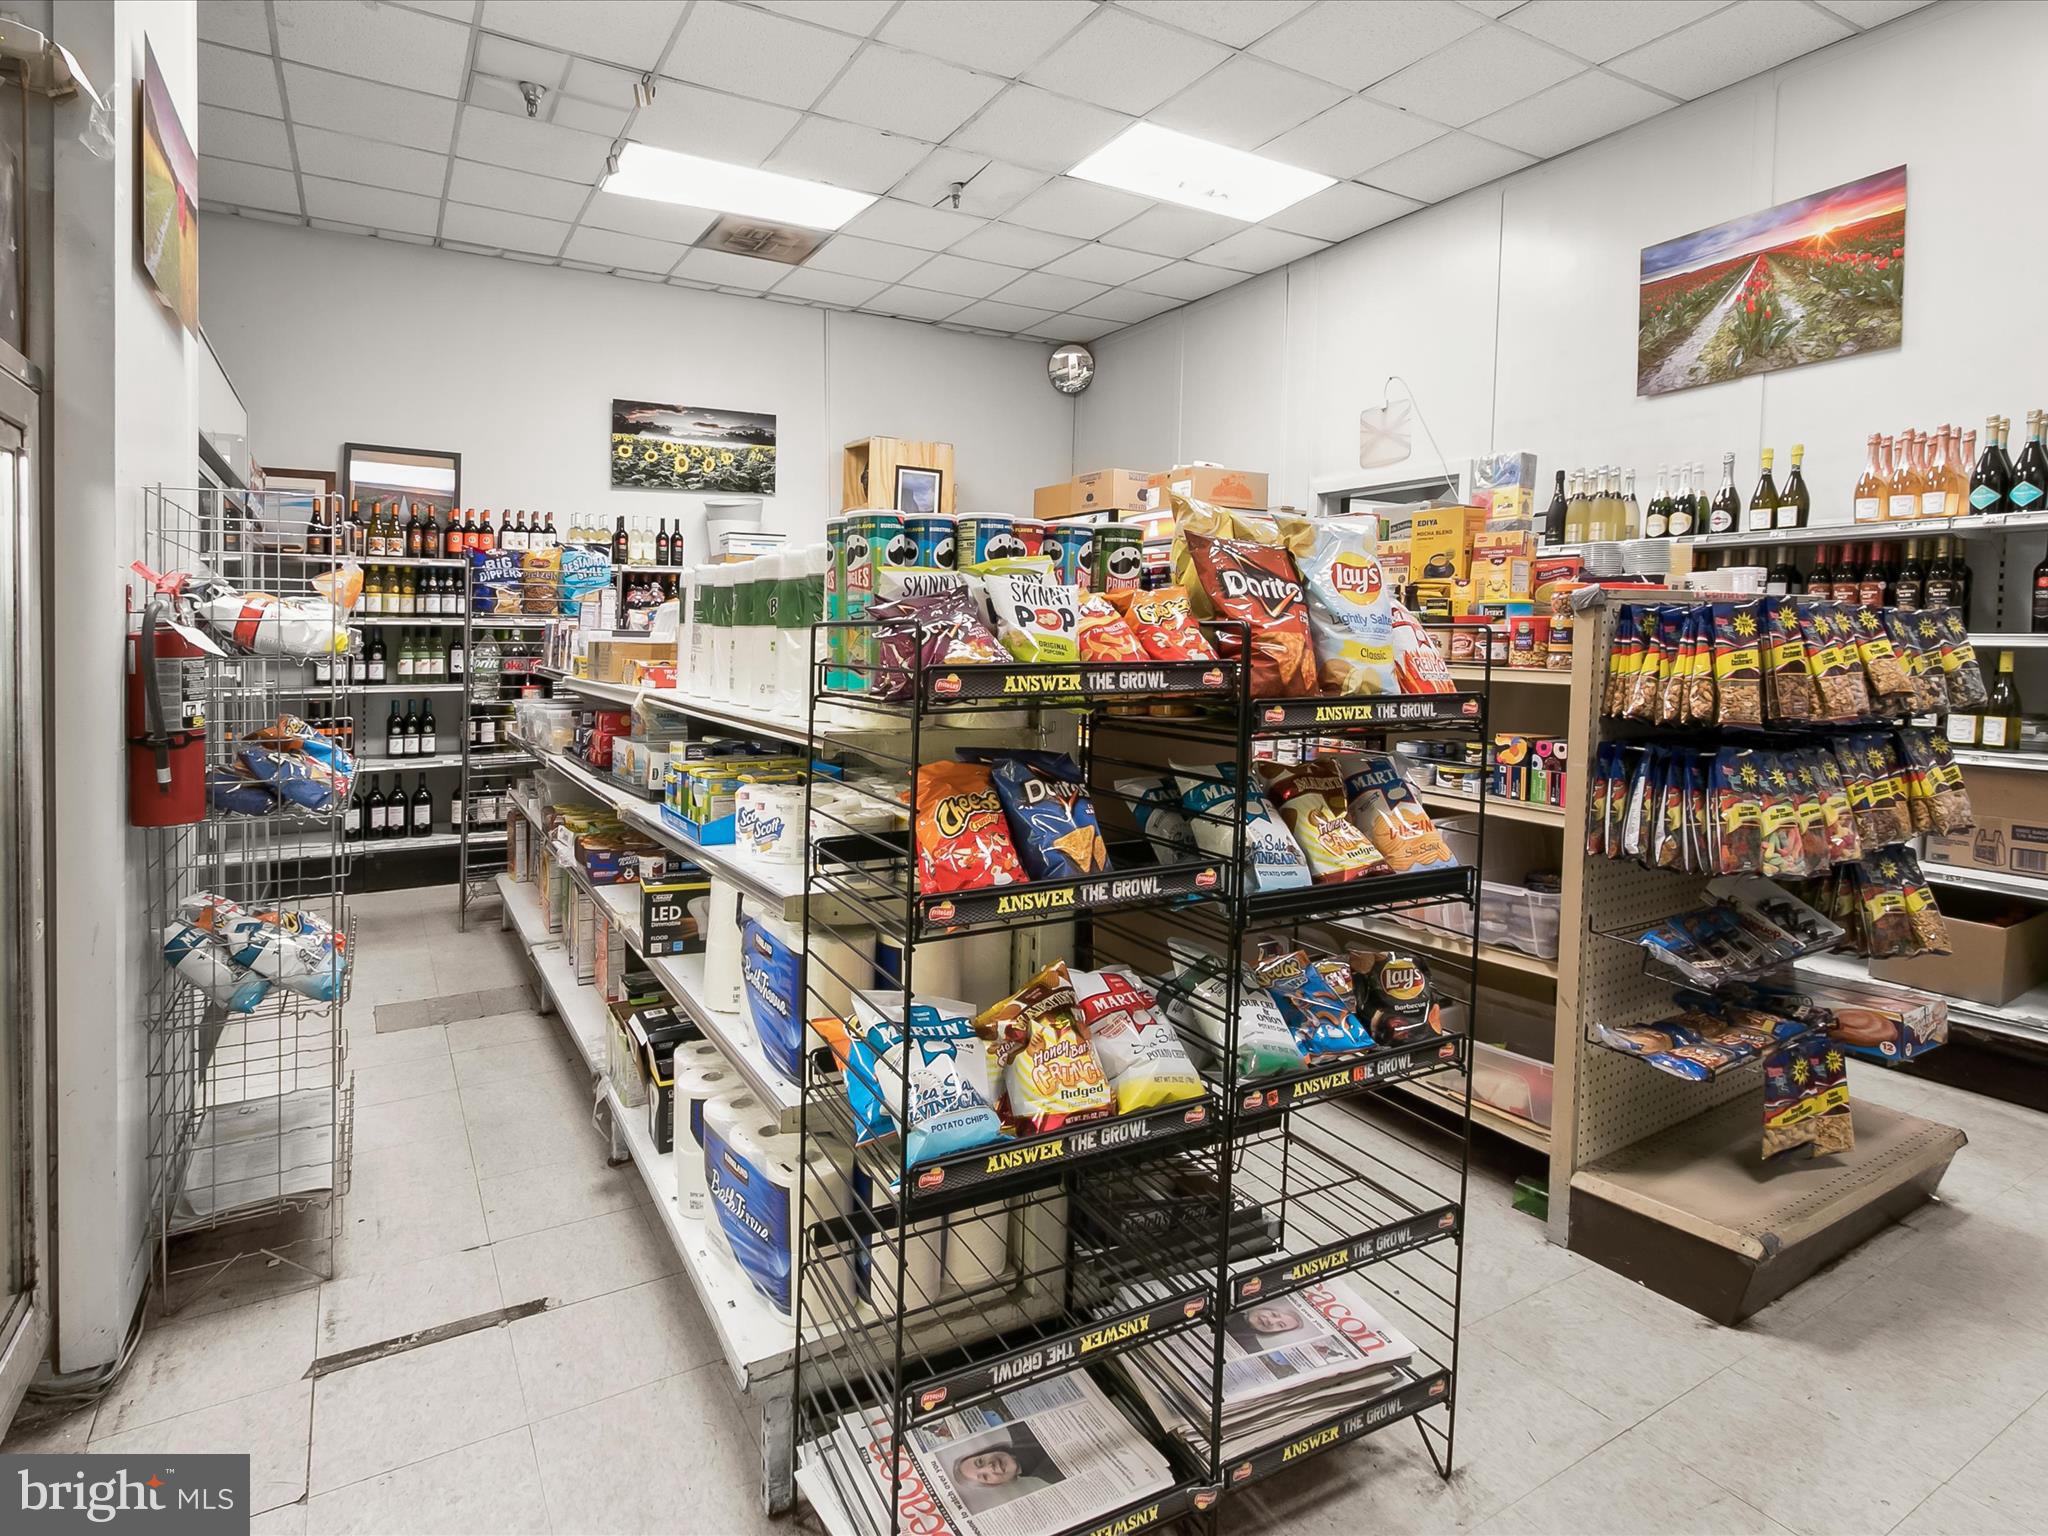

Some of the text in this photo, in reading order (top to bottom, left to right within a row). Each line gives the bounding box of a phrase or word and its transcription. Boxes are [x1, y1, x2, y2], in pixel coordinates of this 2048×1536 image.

[1417, 518, 1438, 527] EDIYA
[1014, 604, 1076, 633] POP
[1003, 669, 1170, 693] ANSWER THE GROWL
[1315, 702, 1437, 722] ANSWER THE GROWL
[754, 816, 781, 838] Scott
[996, 876, 1162, 914] ANSWER THE GROWL
[651, 905, 682, 922] LED
[878, 1020, 977, 1044] MRTIN'S
[1033, 1039, 1069, 1065] Honey
[1882, 1042, 1894, 1052] 12
[1293, 1070, 1351, 1098] ANSWER
[1377, 1053, 1415, 1076] GROWL
[1060, 1083, 1104, 1100] Ridged
[930, 1113, 990, 1134] POTATO CHIPS
[985, 1119, 1151, 1174] ANSWER THE GROWL
[1291, 1227, 1414, 1280] ANSWER THE GROWL
[988, 1314, 1151, 1385] ANSWER THE GROWL
[1281, 1399, 1404, 1462] ANSWER THE GROWL
[939, 1474, 951, 1491] over
[949, 1491, 964, 1511] watch
